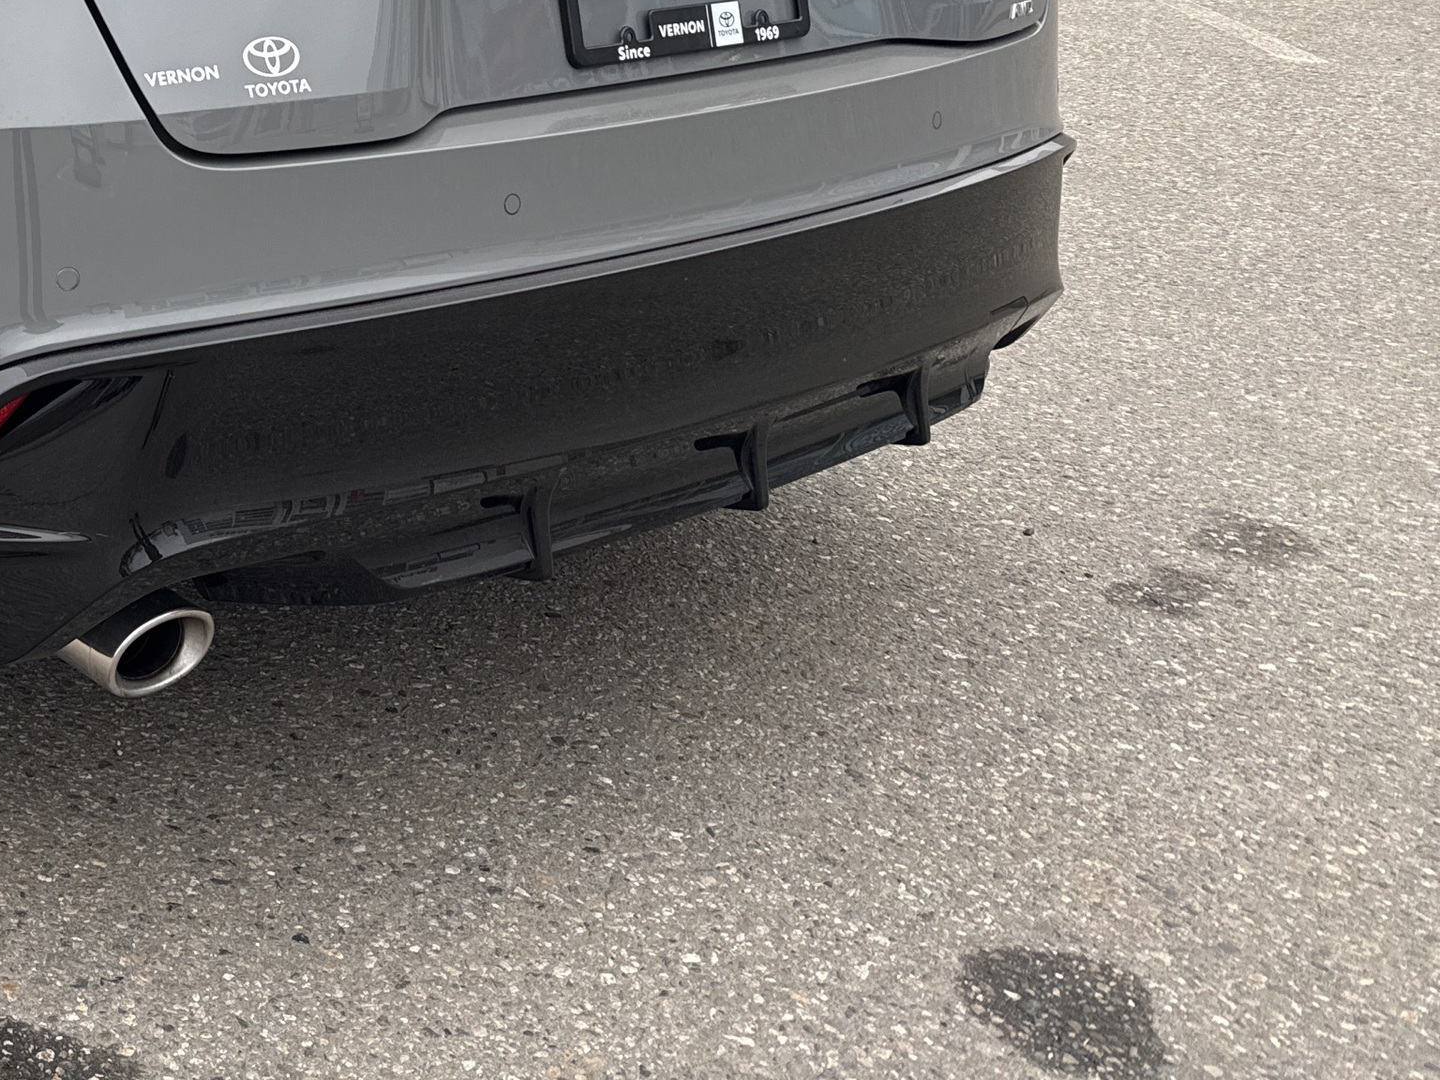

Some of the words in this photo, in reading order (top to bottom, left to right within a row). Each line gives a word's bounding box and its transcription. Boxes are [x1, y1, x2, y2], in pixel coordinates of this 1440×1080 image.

[618, 45, 651, 61] Since
[755, 25, 780, 41] 1969
[659, 20, 705, 37] VERNON
[718, 28, 740, 37] TOYOTA
[144, 65, 220, 87] VERNON
[244, 78, 312, 98] TOYOTA
